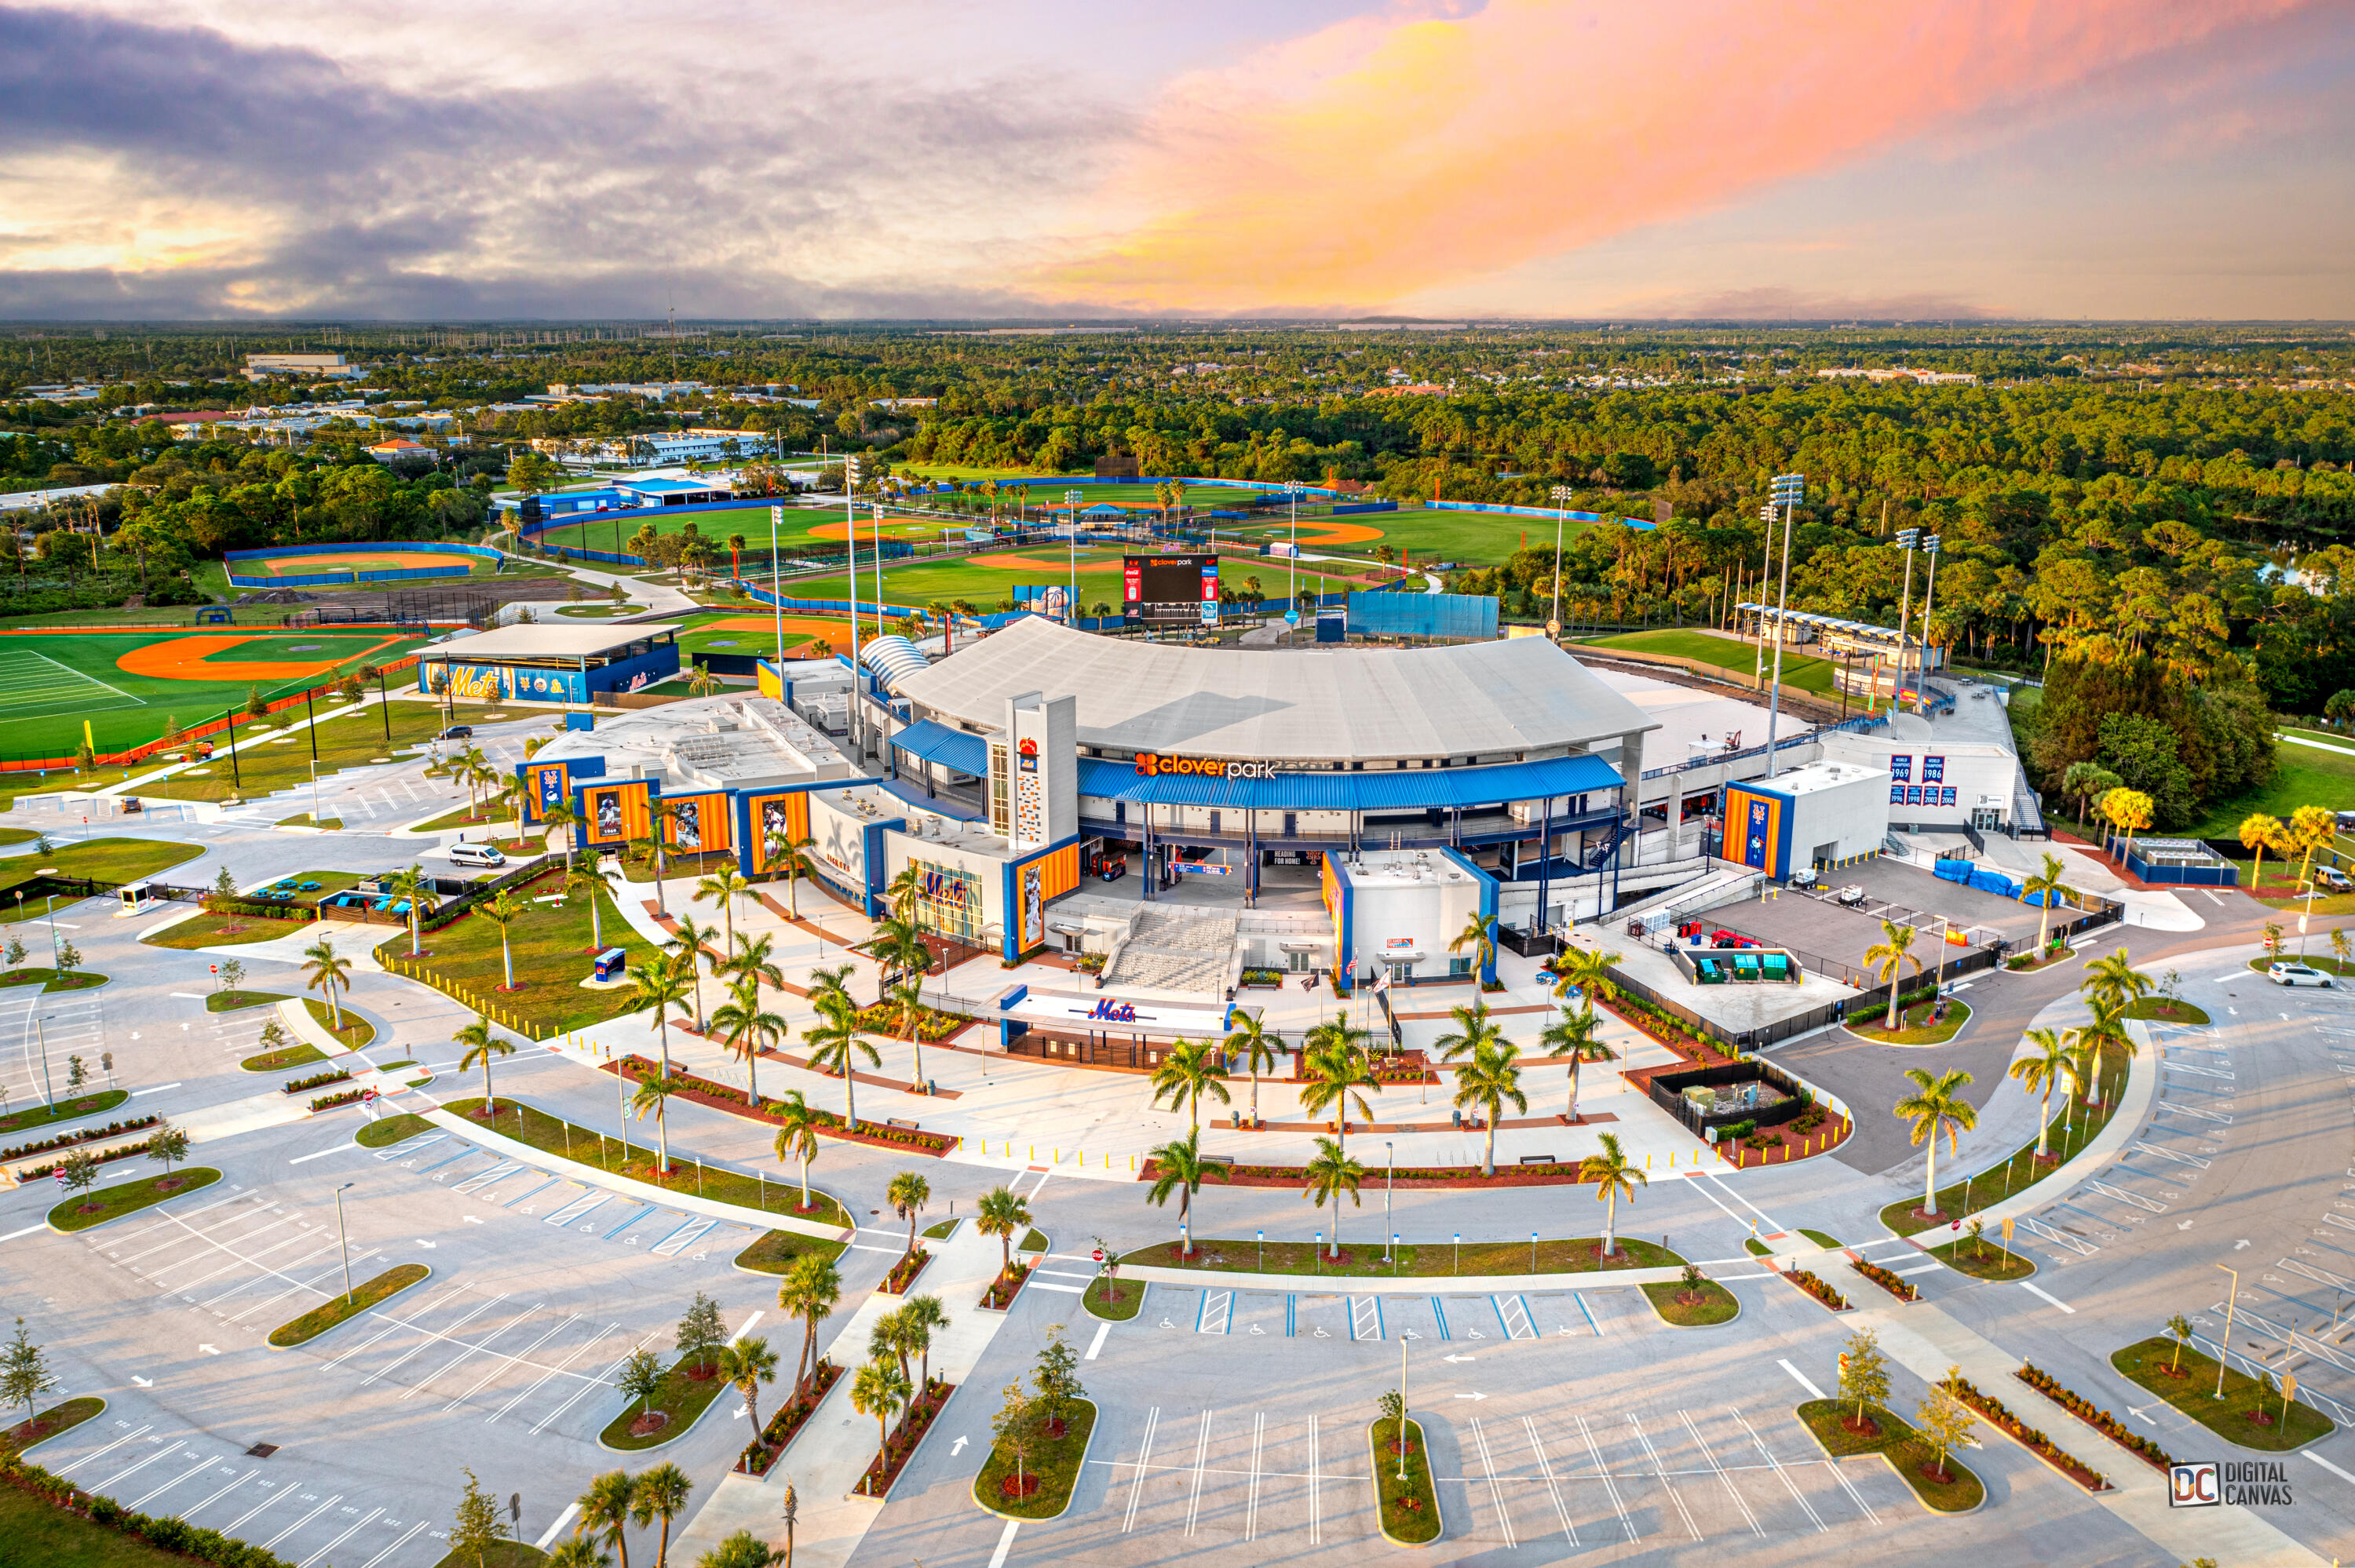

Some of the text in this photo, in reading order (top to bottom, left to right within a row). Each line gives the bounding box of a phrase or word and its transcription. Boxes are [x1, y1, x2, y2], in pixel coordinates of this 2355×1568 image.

[1892, 768, 1909, 778] 1969
[1924, 769, 1941, 778] 1986
[827, 854, 850, 873] TICKETS
[917, 871, 968, 910] Mets
[1087, 997, 1136, 1023] Mets
[220, 1466, 237, 1475] 225
[300, 1493, 318, 1501] 227
[429, 1530, 448, 1539] 230
